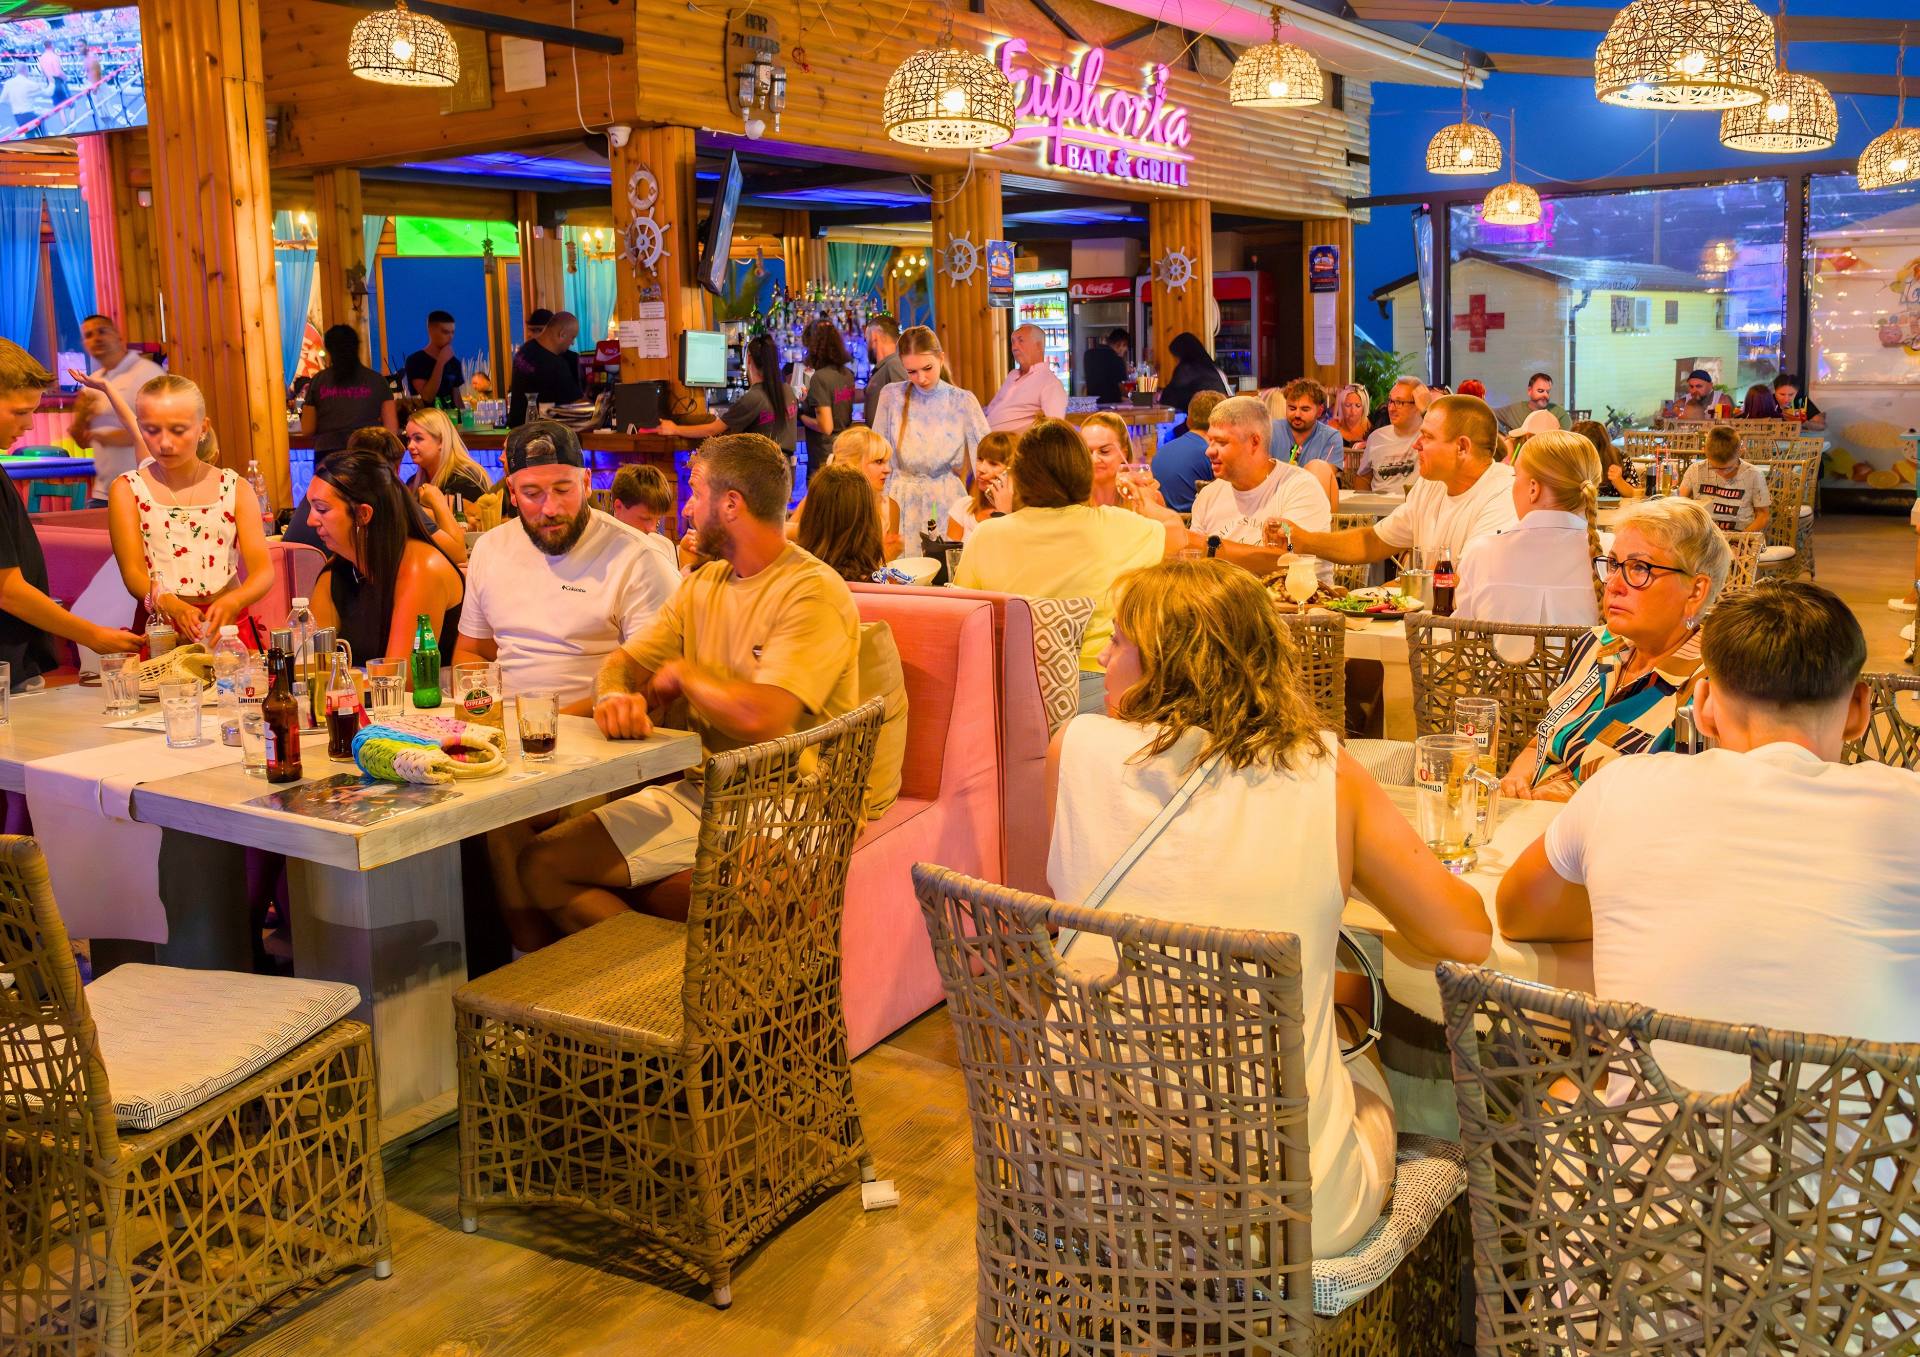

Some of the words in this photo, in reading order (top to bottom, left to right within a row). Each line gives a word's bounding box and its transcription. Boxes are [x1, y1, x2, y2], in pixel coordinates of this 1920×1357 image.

[1001, 38, 1193, 167] Euphoria
[1066, 145, 1110, 174] BAR
[1112, 148, 1132, 177] &
[1135, 157, 1190, 187] GRILL
